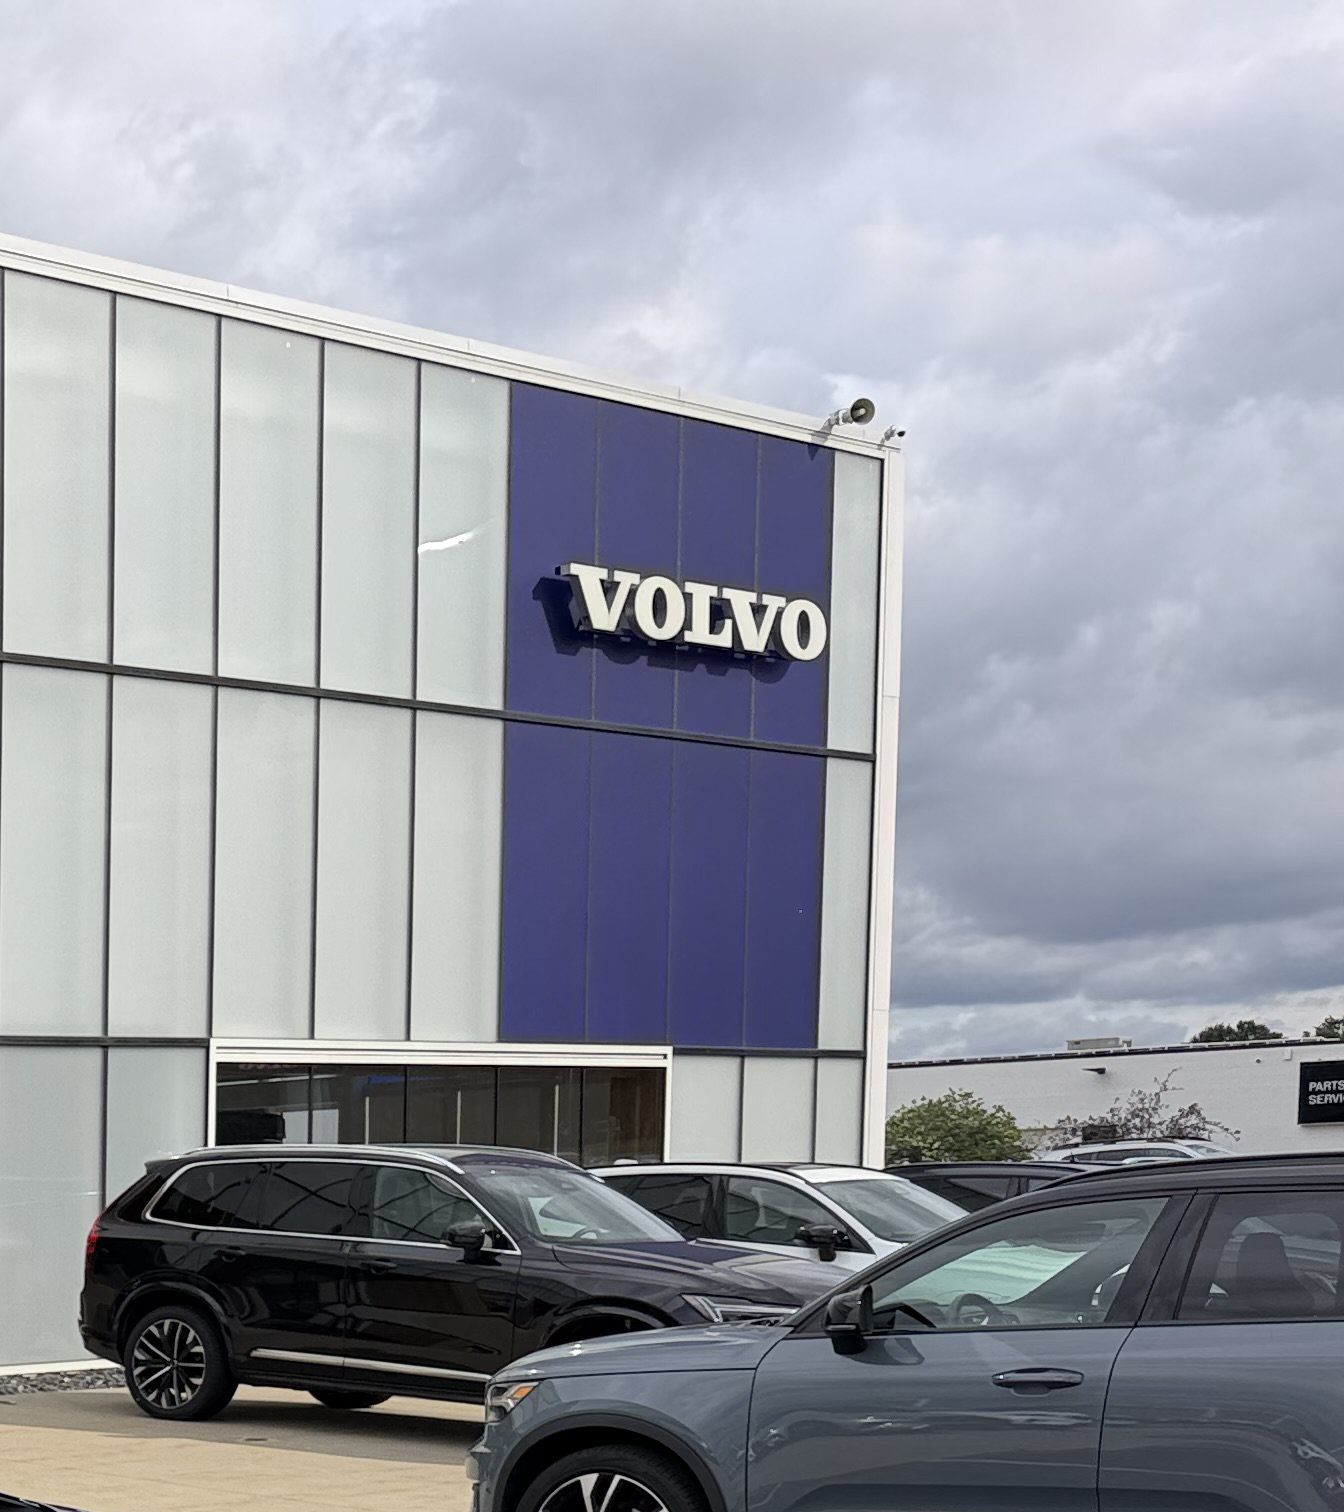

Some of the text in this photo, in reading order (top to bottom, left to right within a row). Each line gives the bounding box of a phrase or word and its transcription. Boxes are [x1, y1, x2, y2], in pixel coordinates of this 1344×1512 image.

[565, 561, 828, 662] VOLVO
[1308, 1080, 1344, 1092] PARTS
[1308, 1093, 1344, 1105] SERVI
